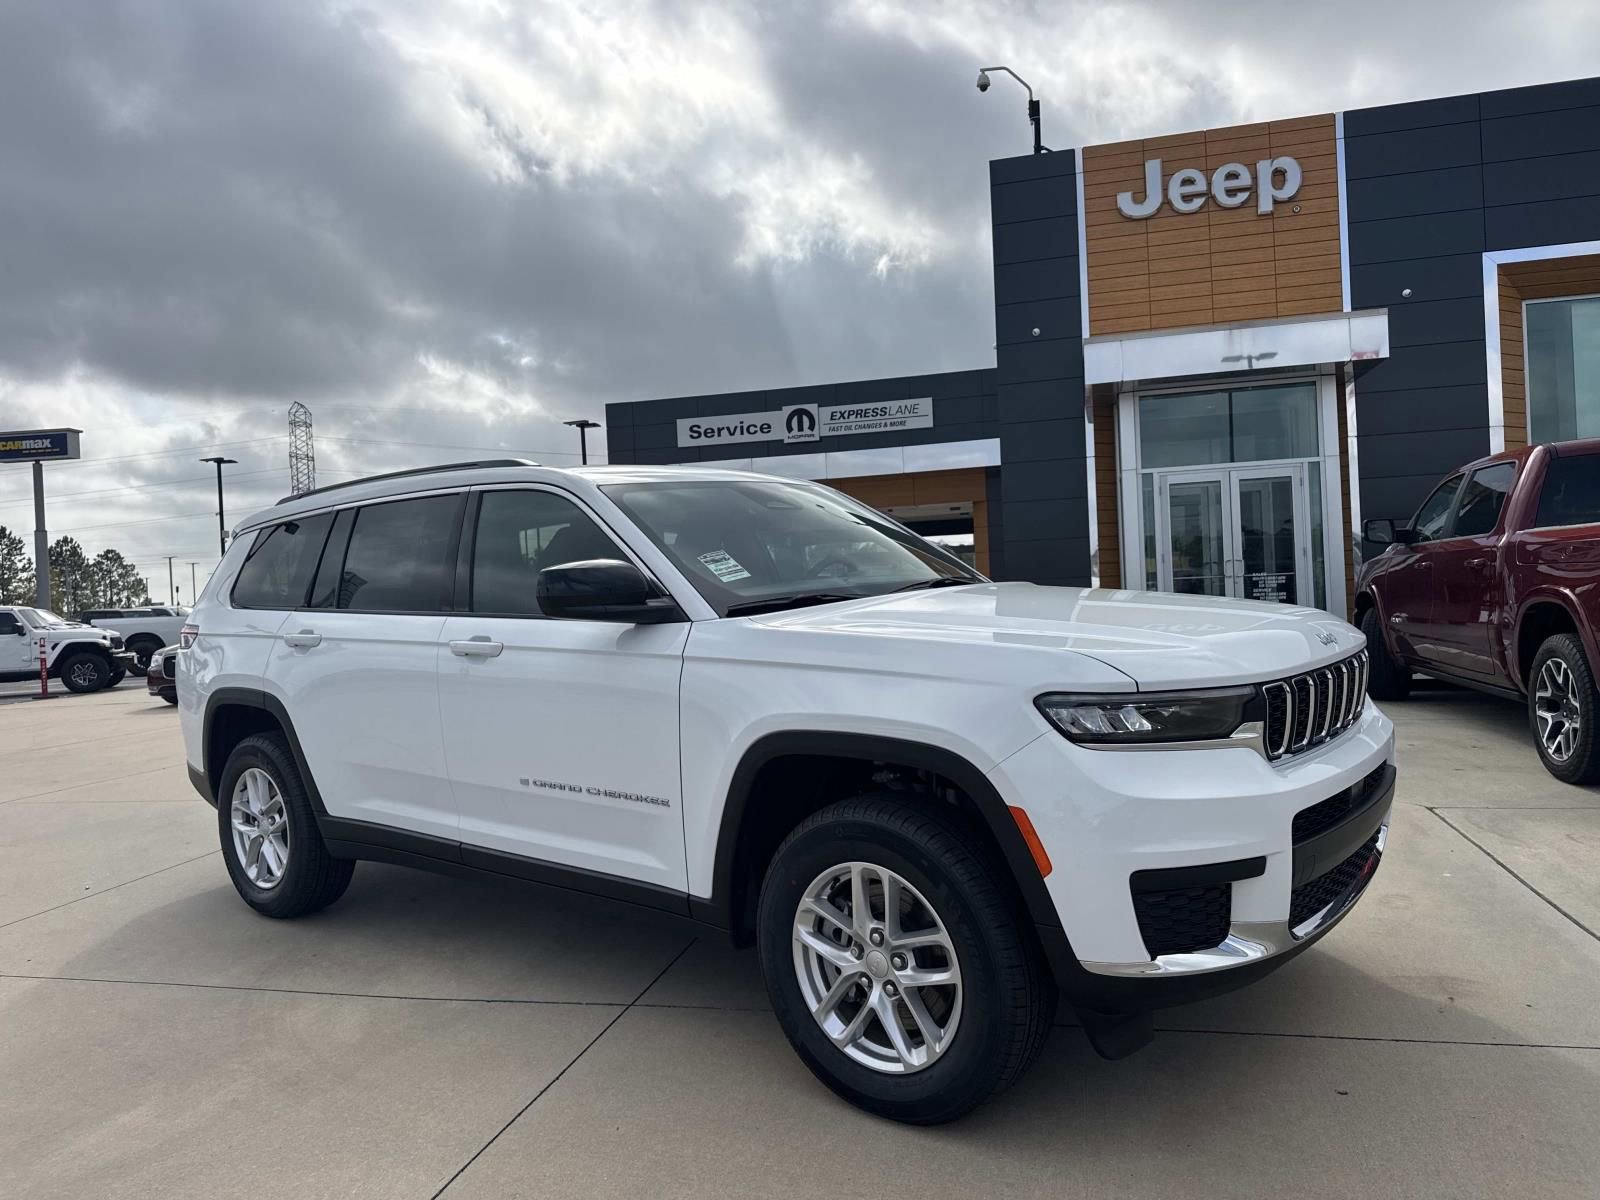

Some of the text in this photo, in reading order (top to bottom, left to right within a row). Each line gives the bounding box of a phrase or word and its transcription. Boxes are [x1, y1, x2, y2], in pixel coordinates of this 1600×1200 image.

[1116, 156, 1302, 219] Jeep
[689, 421, 772, 439] Service
[854, 422, 882, 430] CHANGES
[532, 779, 670, 807] GRAND CHEROKEE
